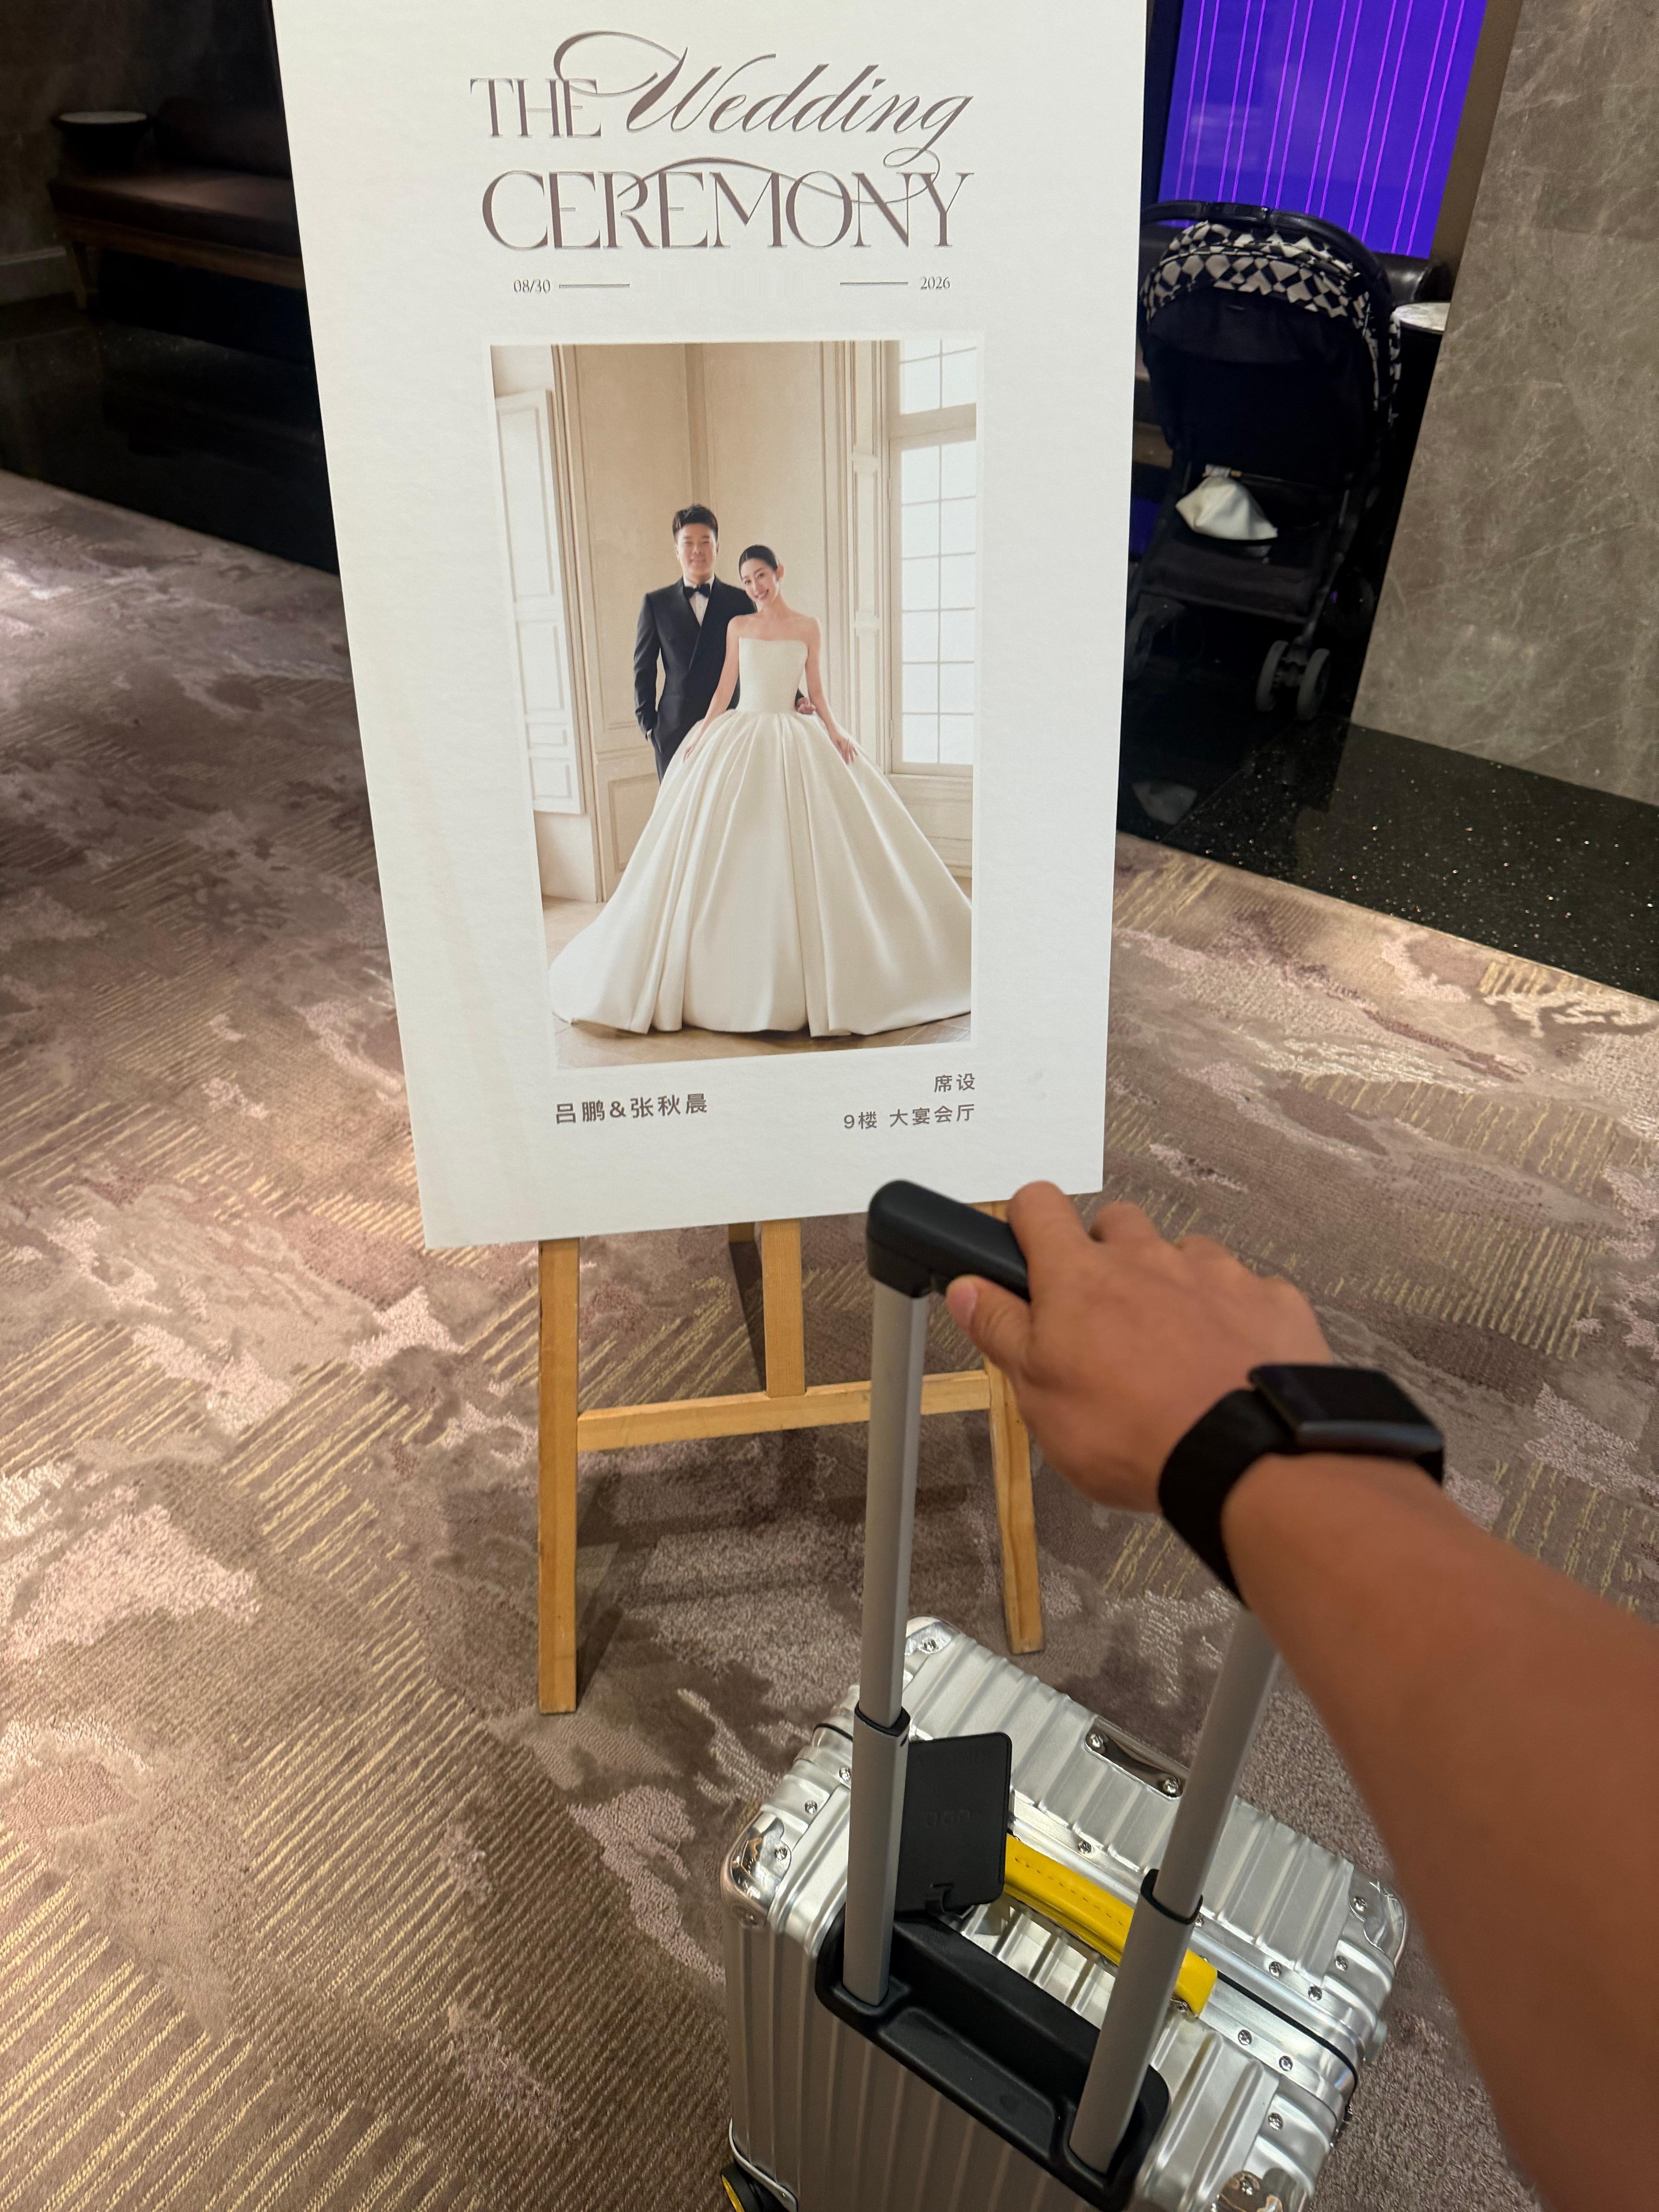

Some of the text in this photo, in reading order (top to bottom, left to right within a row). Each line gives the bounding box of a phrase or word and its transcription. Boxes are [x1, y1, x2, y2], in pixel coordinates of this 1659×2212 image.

[470, 31, 974, 167] THE Wedding
[482, 167, 975, 251] CEREMONY
[514, 278, 551, 294] 08/30
[920, 276, 951, 290] 2026
[934, 1073, 975, 1093] 席设
[556, 1093, 708, 1125] 吕鹏&张秋晨
[843, 1104, 975, 1130] 9楼 大宴会厅
